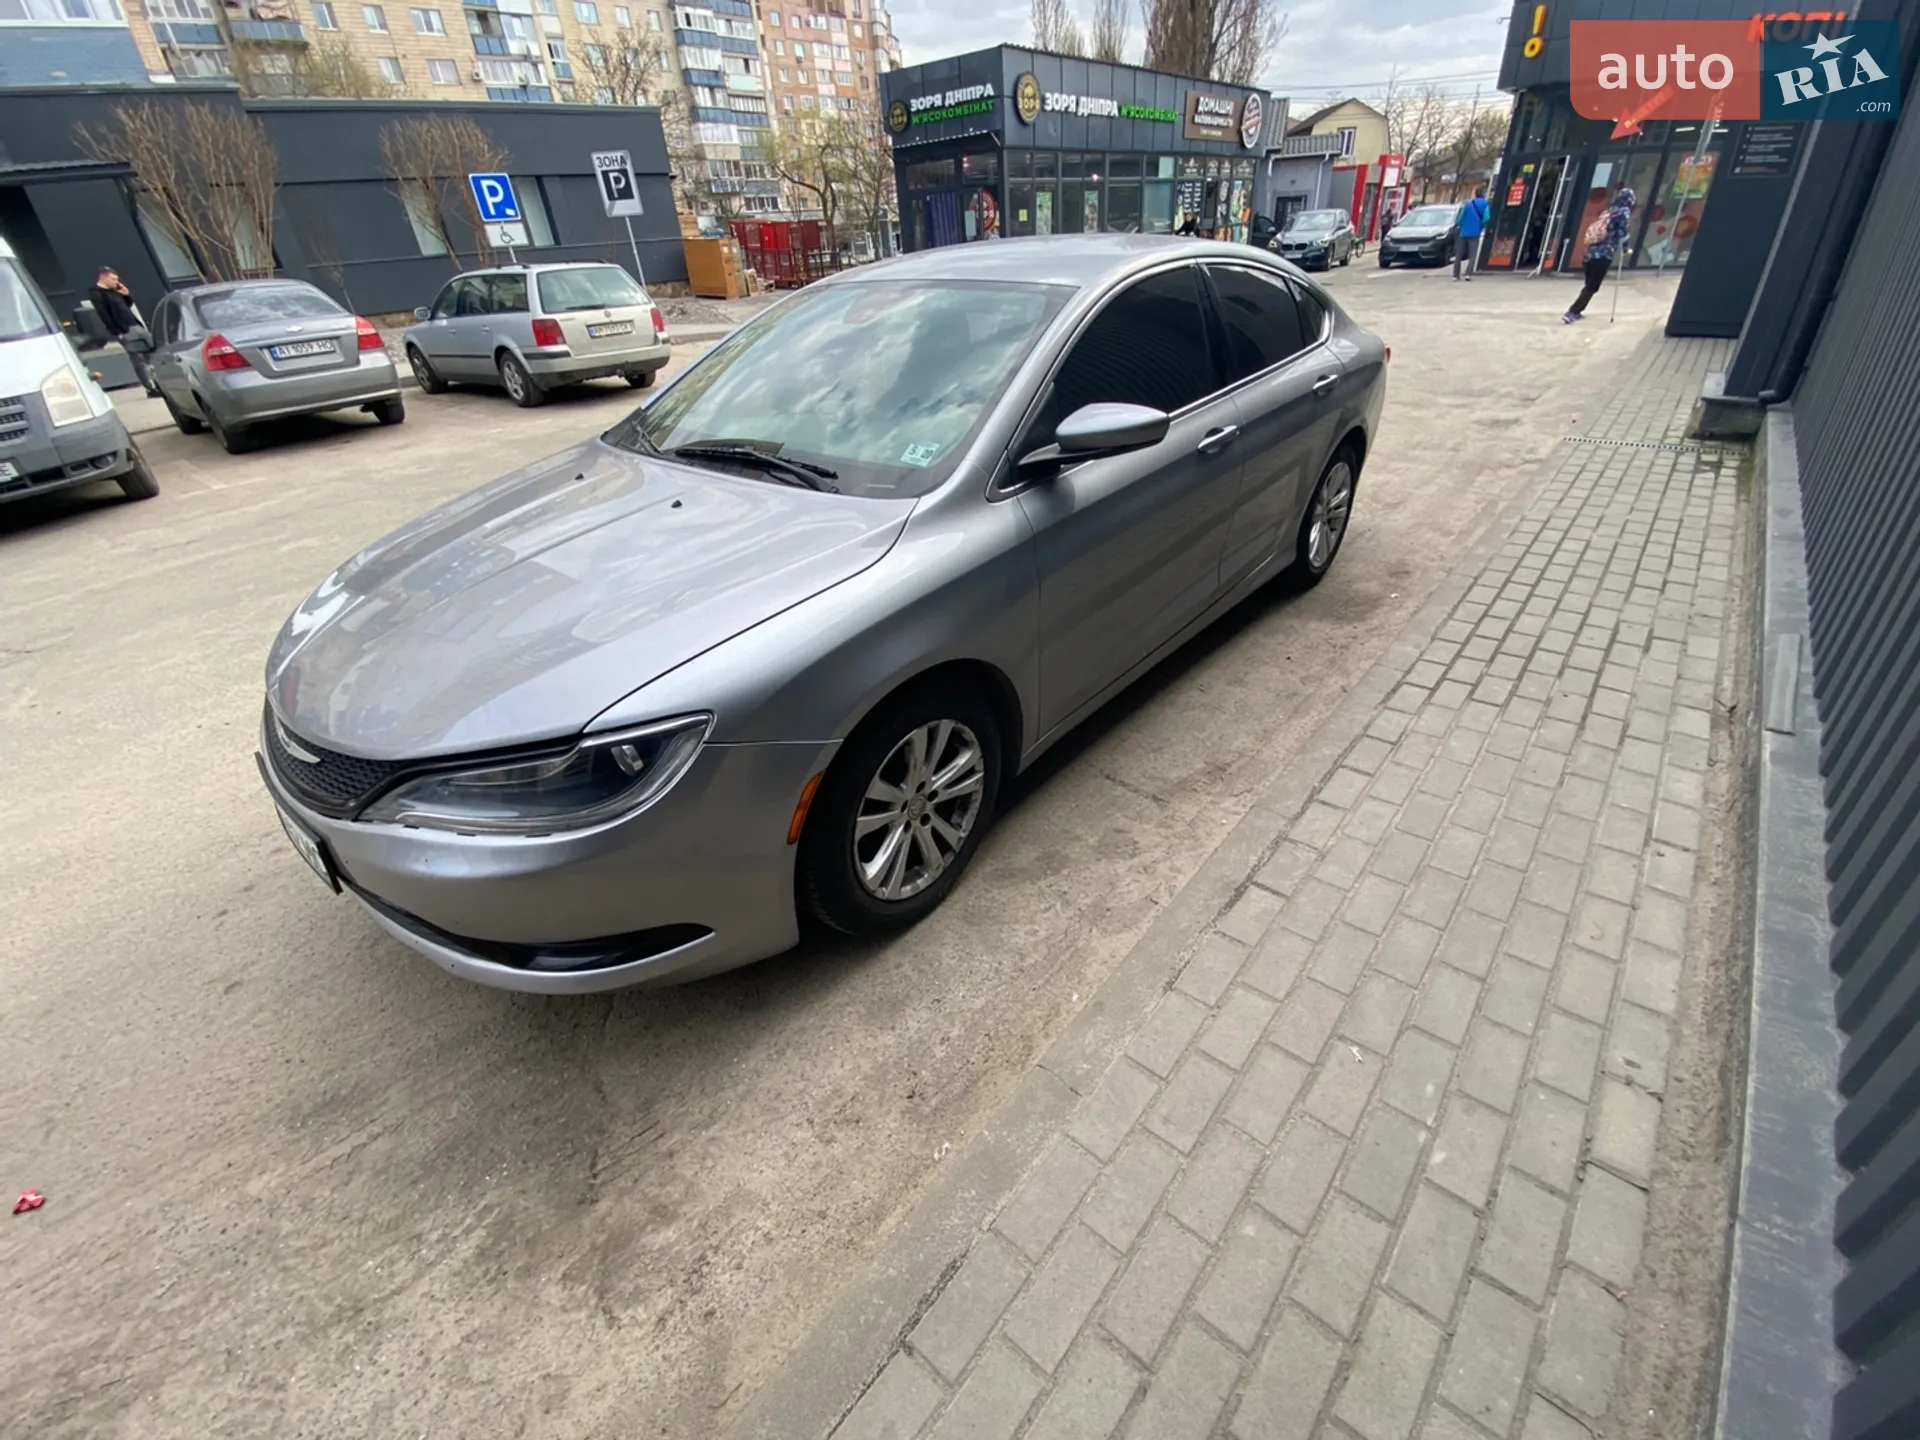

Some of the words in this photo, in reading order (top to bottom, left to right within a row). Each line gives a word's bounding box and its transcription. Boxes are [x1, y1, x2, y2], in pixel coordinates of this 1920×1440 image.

[910, 94, 943, 112] ЗОРЯ
[944, 83, 995, 107] ДНІПРА
[1044, 92, 1077, 112] ЗОРЯ
[1077, 97, 1119, 117] ДНІПРА
[596, 155, 628, 168] ЗОНА
